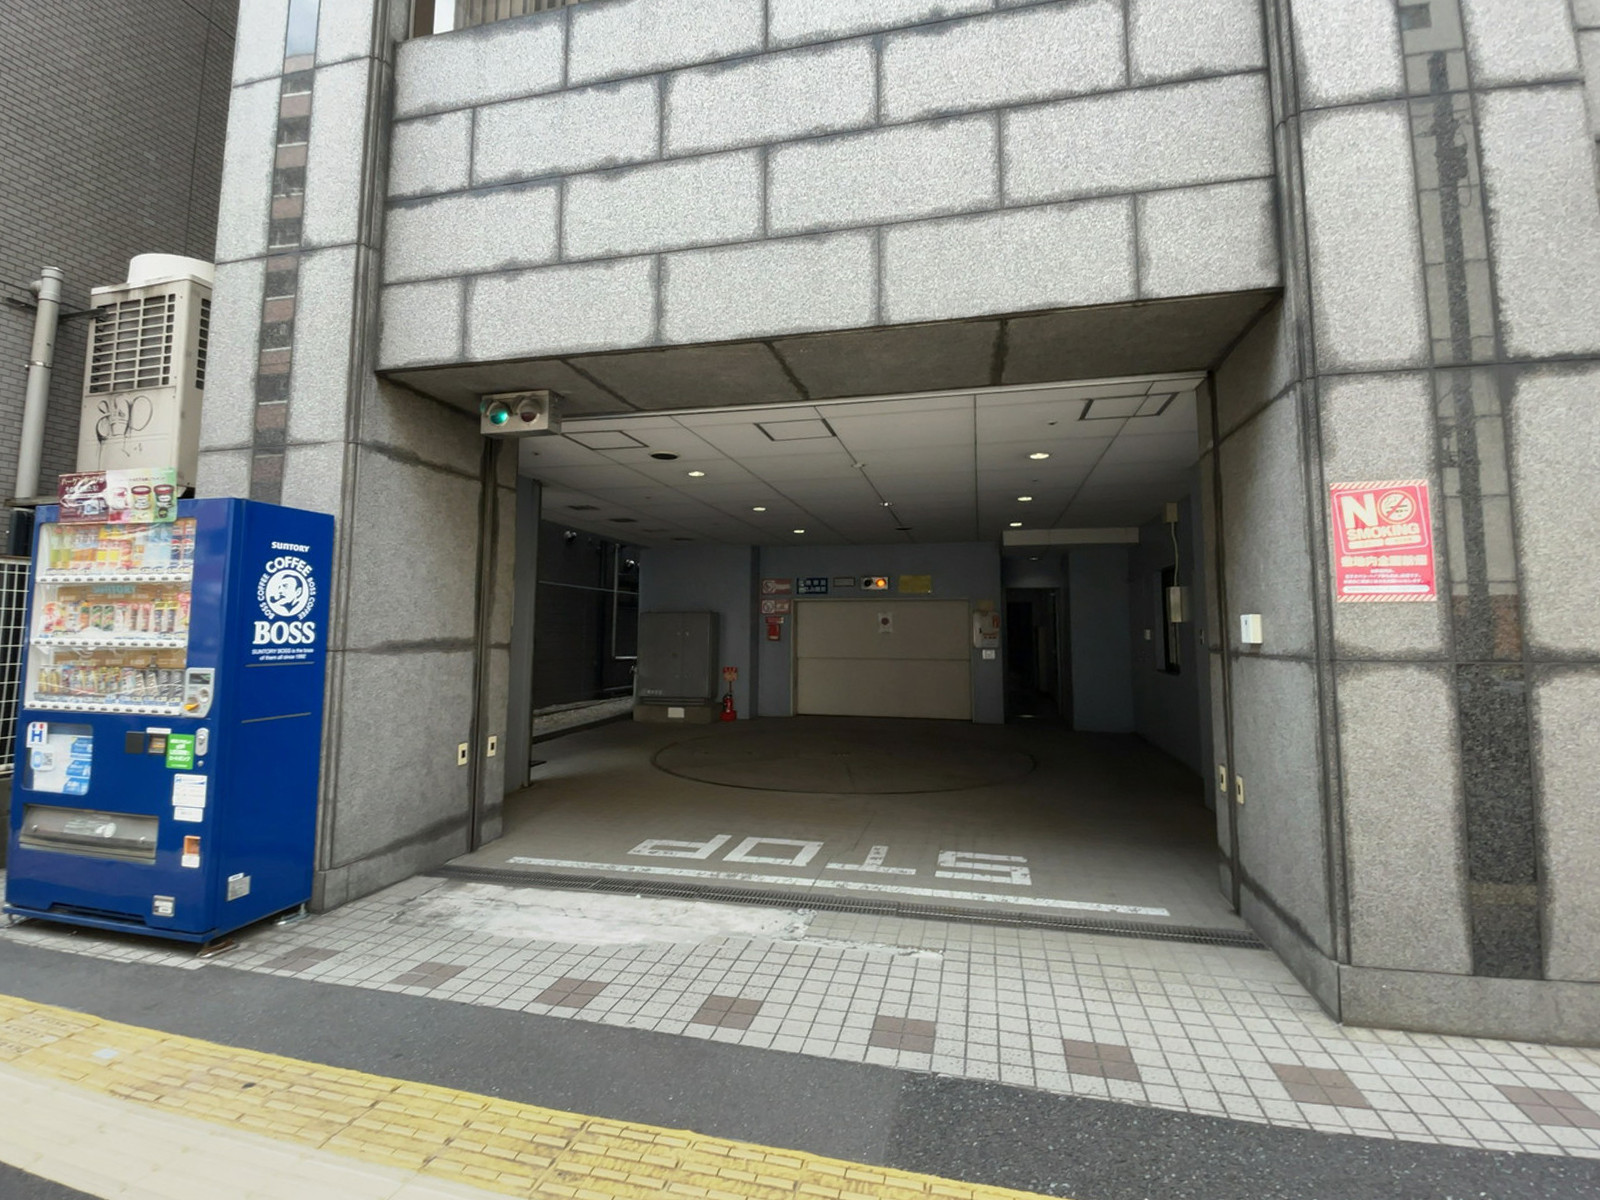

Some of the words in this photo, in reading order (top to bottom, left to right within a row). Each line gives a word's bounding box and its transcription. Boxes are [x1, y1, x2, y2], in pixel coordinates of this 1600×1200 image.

[1346, 522, 1420, 541] SMOKING
[271, 541, 310, 552] SUNTORY
[265, 556, 313, 577] COFFEE
[257, 573, 270, 601] COFFEE
[307, 577, 316, 595] BOSS
[259, 602, 275, 620] BOSS
[298, 597, 315, 620] COFFEE
[252, 620, 316, 645] BOSS
[627, 833, 1033, 886] STOP
